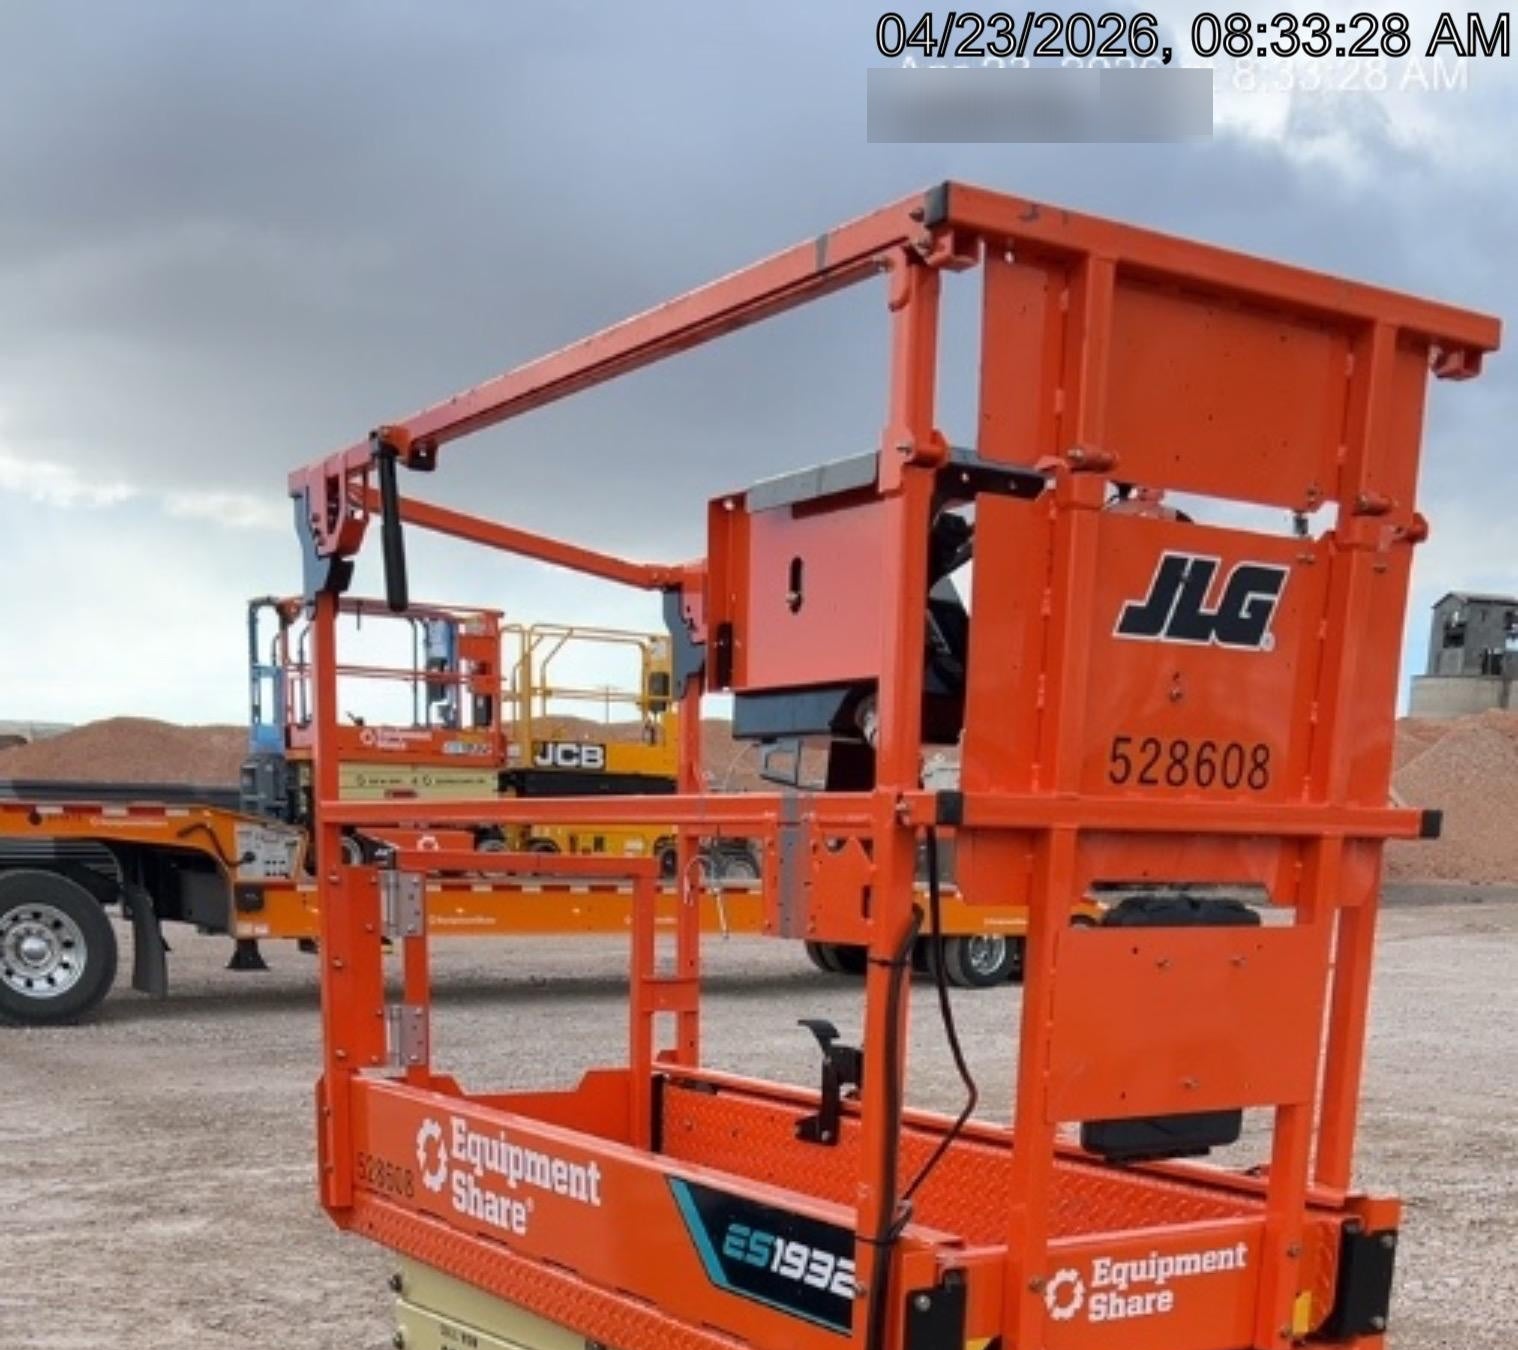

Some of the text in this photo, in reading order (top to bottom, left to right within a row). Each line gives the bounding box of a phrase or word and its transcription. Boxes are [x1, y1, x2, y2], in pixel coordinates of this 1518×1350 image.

[1113, 551, 1290, 650] JLG
[535, 743, 604, 768] JCB
[1109, 736, 1270, 790] 528608
[449, 1115, 602, 1207] Equipment
[451, 1168, 528, 1237] Share
[723, 1223, 857, 1299] ES1932
[1091, 1241, 1248, 1290] Equipment
[1088, 1288, 1174, 1323] Share
